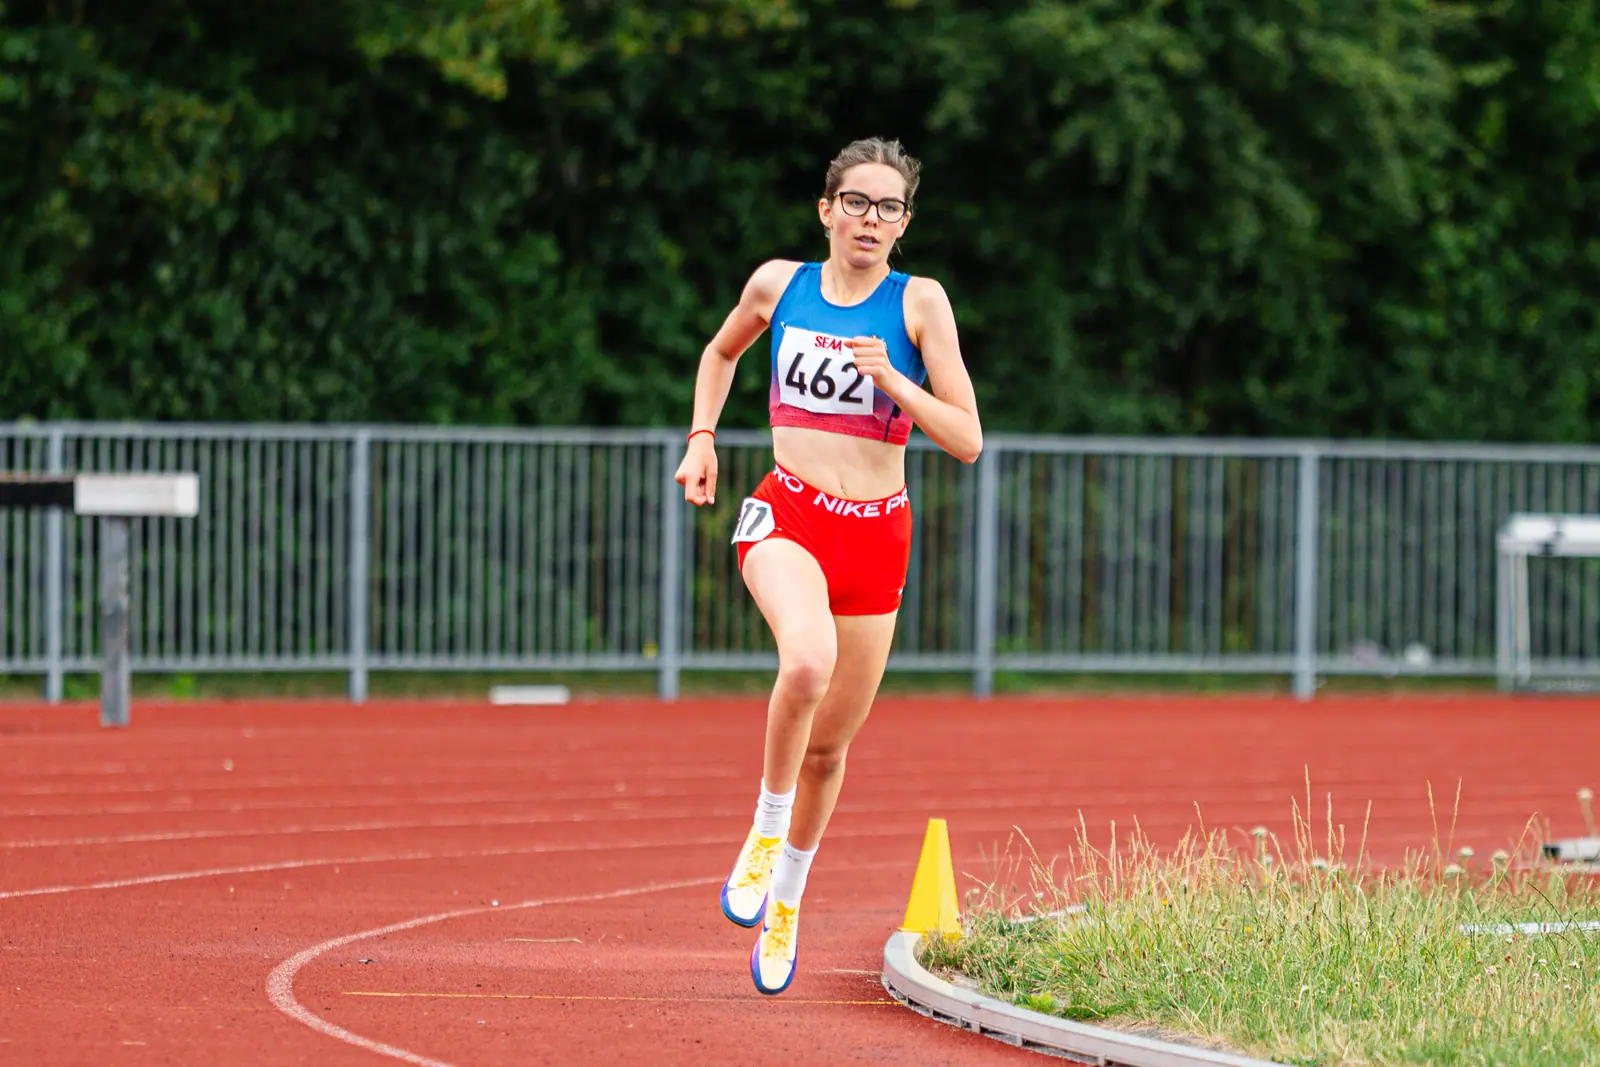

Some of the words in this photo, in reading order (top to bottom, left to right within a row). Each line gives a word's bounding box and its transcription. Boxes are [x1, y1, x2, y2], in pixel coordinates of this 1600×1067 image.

[785, 352, 864, 404] 462
[773, 464, 804, 493] RO
[813, 491, 884, 518] NIKE
